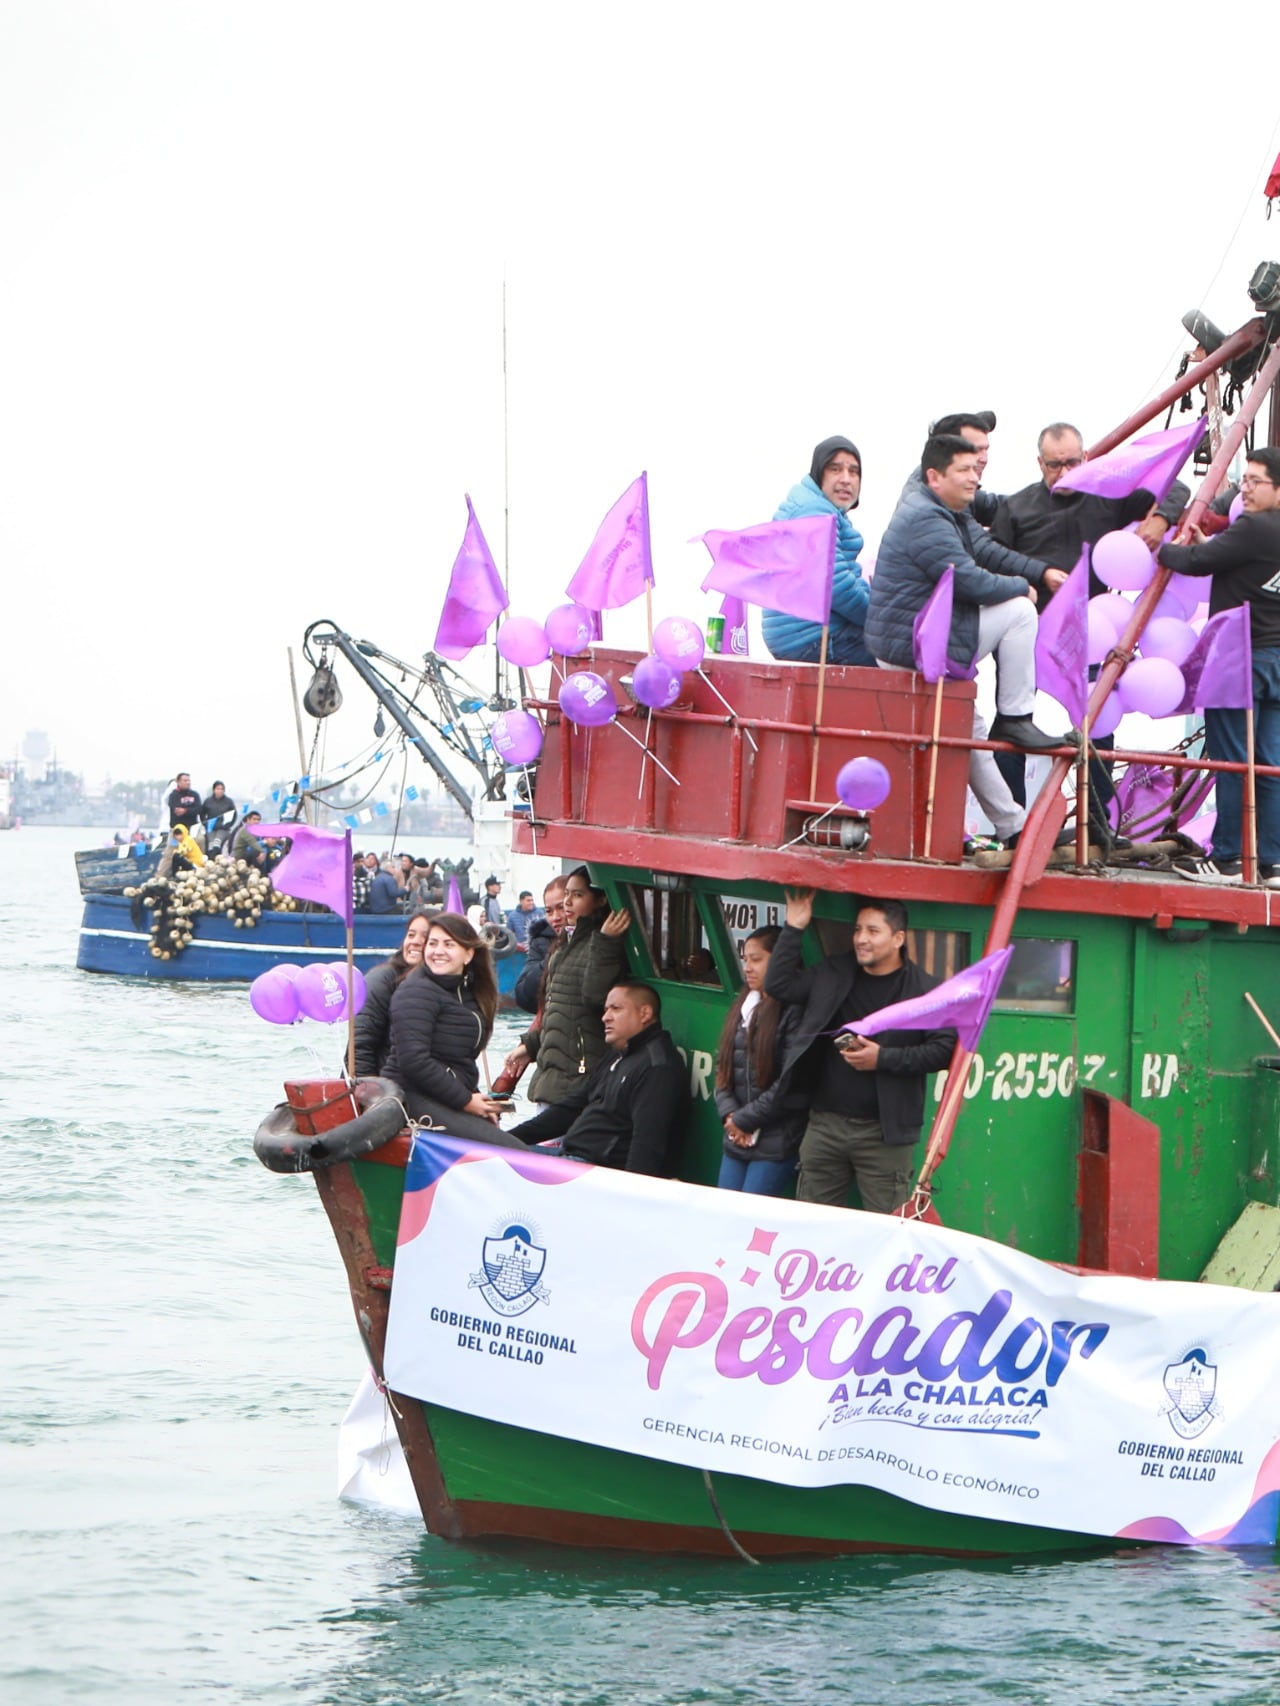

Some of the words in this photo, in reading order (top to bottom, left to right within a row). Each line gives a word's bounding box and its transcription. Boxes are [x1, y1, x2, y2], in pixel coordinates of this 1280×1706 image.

[774, 1248, 864, 1301] Día
[885, 1253, 959, 1295] del
[430, 1306, 502, 1337] GOBIERNO
[505, 1325, 577, 1354] REGIONAL
[631, 1271, 1110, 1391] Pescador
[457, 1333, 484, 1352] DEL
[488, 1341, 544, 1366] CALLAO
[828, 1383, 849, 1404] A
[855, 1378, 892, 1398] LA
[903, 1381, 1048, 1408] CHALACA
[867, 1398, 912, 1418] hecho
[917, 1412, 930, 1427] y
[934, 1414, 961, 1425] con
[968, 1408, 1042, 1430] alegría!
[643, 1417, 725, 1444] GERENCIA
[730, 1434, 813, 1461] REGIONAL
[817, 1449, 836, 1462] DE
[838, 1445, 938, 1481] DESARROLLO
[942, 1472, 1040, 1499] ECONÓMICO
[1117, 1440, 1185, 1462] GOBIERNO
[1187, 1447, 1244, 1465] REGIONAL
[1140, 1462, 1166, 1479] DEL
[1168, 1464, 1217, 1482] CALLAO
